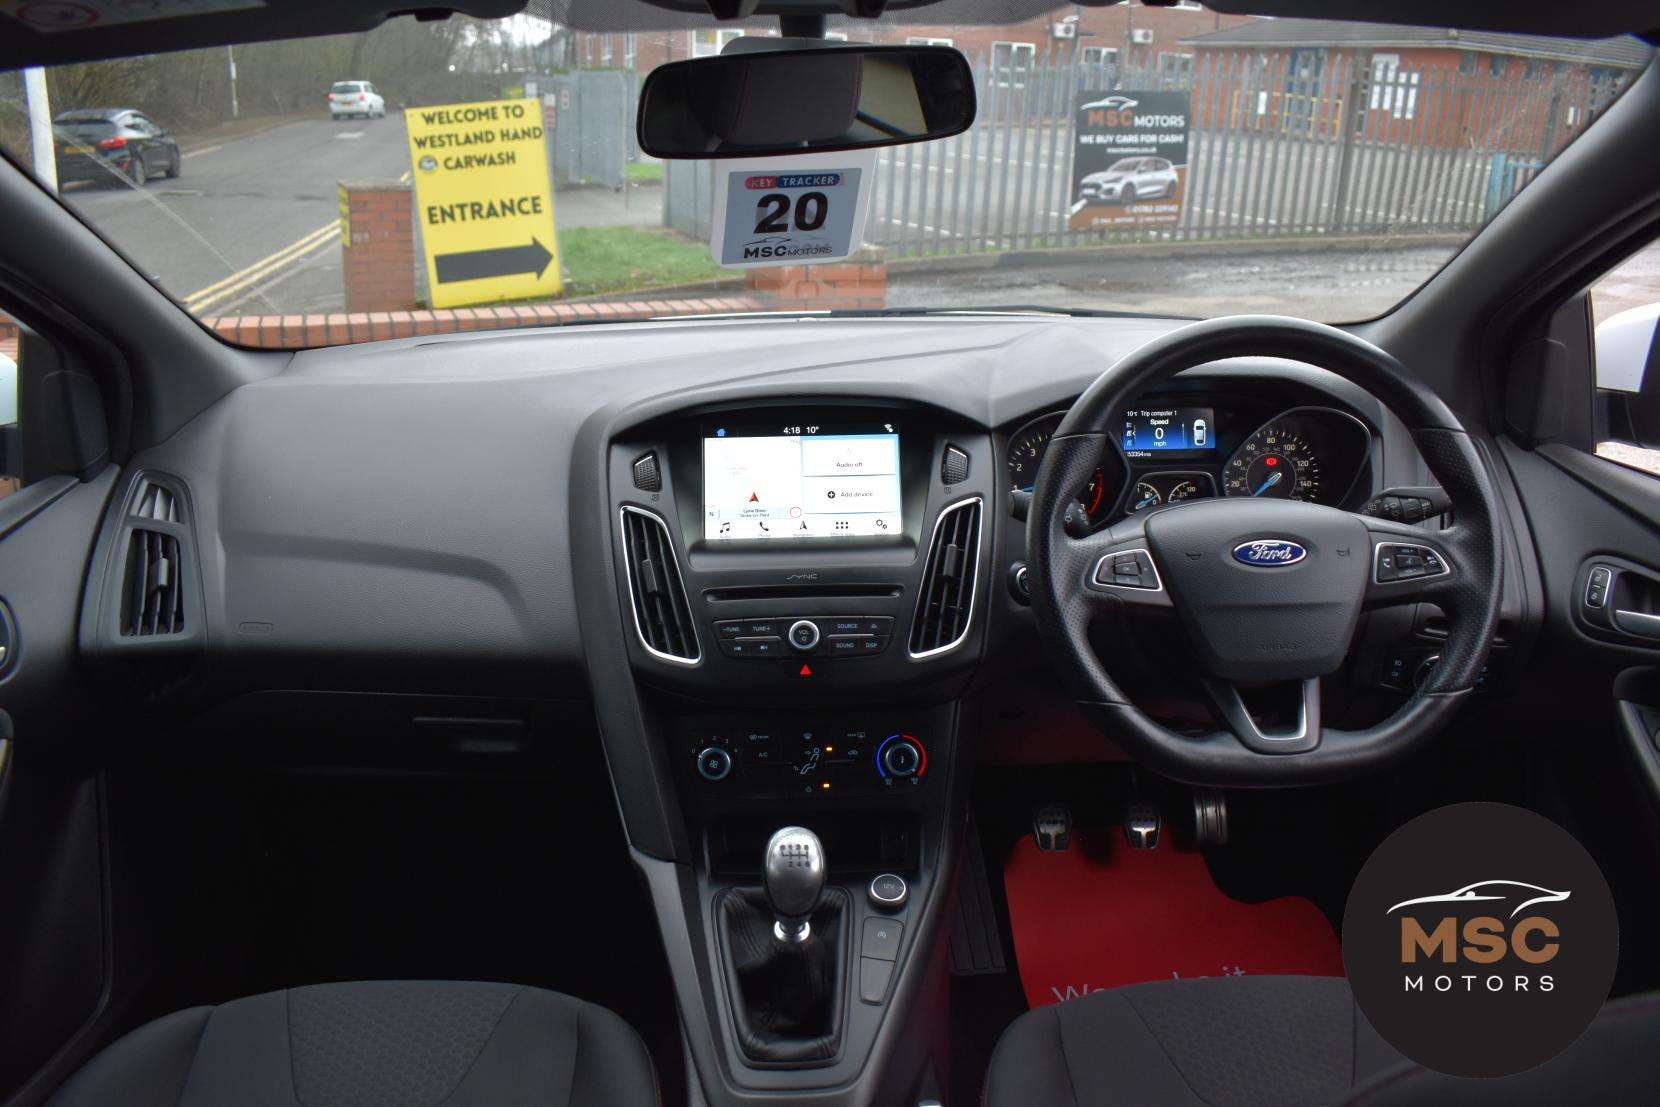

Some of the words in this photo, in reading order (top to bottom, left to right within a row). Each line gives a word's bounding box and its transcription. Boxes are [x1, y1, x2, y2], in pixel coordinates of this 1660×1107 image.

[421, 106, 499, 125] WELCOME
[501, 104, 525, 119] TO
[1087, 109, 1134, 128] MSC
[1134, 115, 1186, 128] MOTORS
[413, 130, 496, 149] WESTLAND
[500, 126, 544, 142] HAND
[1079, 134, 1095, 144] WE
[1095, 134, 1115, 144] BUY
[1115, 134, 1139, 144] CARS
[1140, 134, 1158, 144] FOR
[443, 151, 516, 171] CARWASH
[751, 178, 773, 188] KEY
[782, 176, 836, 187] TRACKER
[427, 196, 543, 225] ENTRANCE
[753, 191, 829, 235] 20
[743, 245, 787, 259] MSC
[787, 246, 833, 257] MOTORS
[1140, 410, 1151, 418] Trip
[1150, 418, 1169, 426] Speed
[783, 426, 802, 435] 4:18
[1155, 427, 1164, 440] 0
[1030, 448, 1036, 456] 3
[1283, 443, 1296, 451] 100
[1248, 541, 1293, 561] Ford
[798, 629, 811, 637] VOL
[836, 641, 856, 649] SOUND
